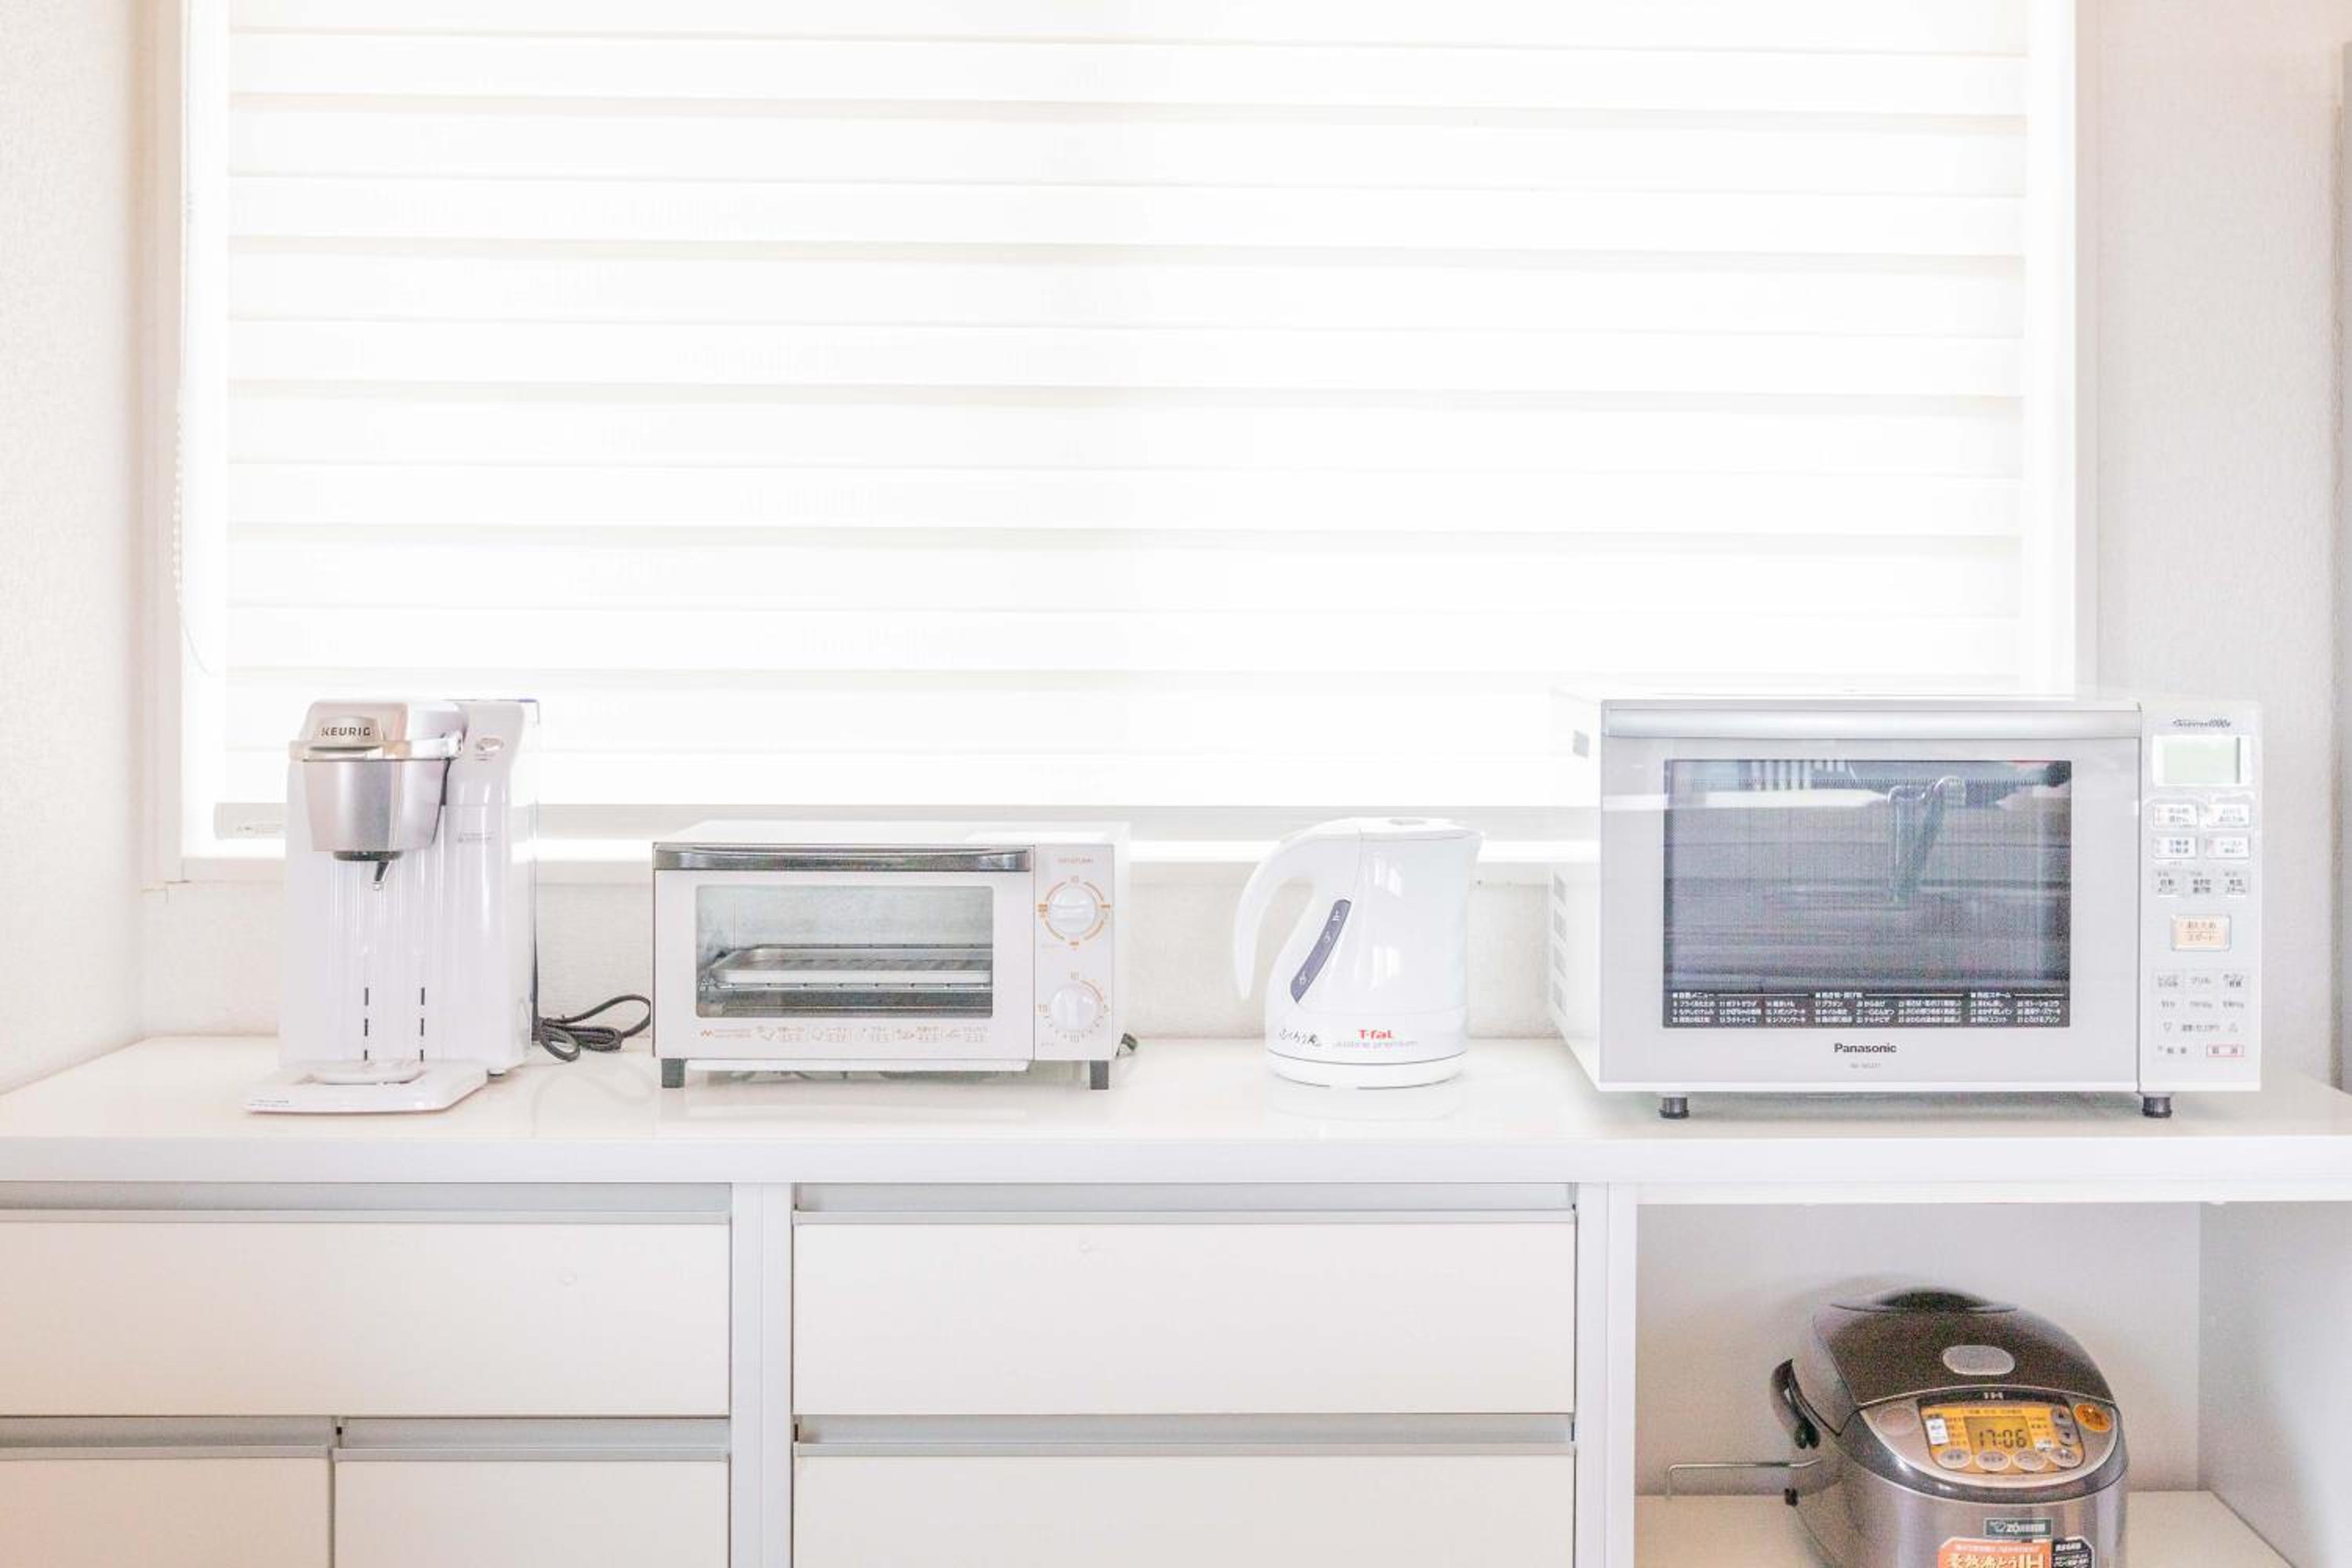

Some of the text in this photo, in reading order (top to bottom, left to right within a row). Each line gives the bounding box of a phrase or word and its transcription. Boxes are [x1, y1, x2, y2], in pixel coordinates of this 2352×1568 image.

[321, 727, 371, 736] KEURIG
[1834, 1042, 1897, 1053] Panasonic
[1976, 1429, 2027, 1449] 17:06
